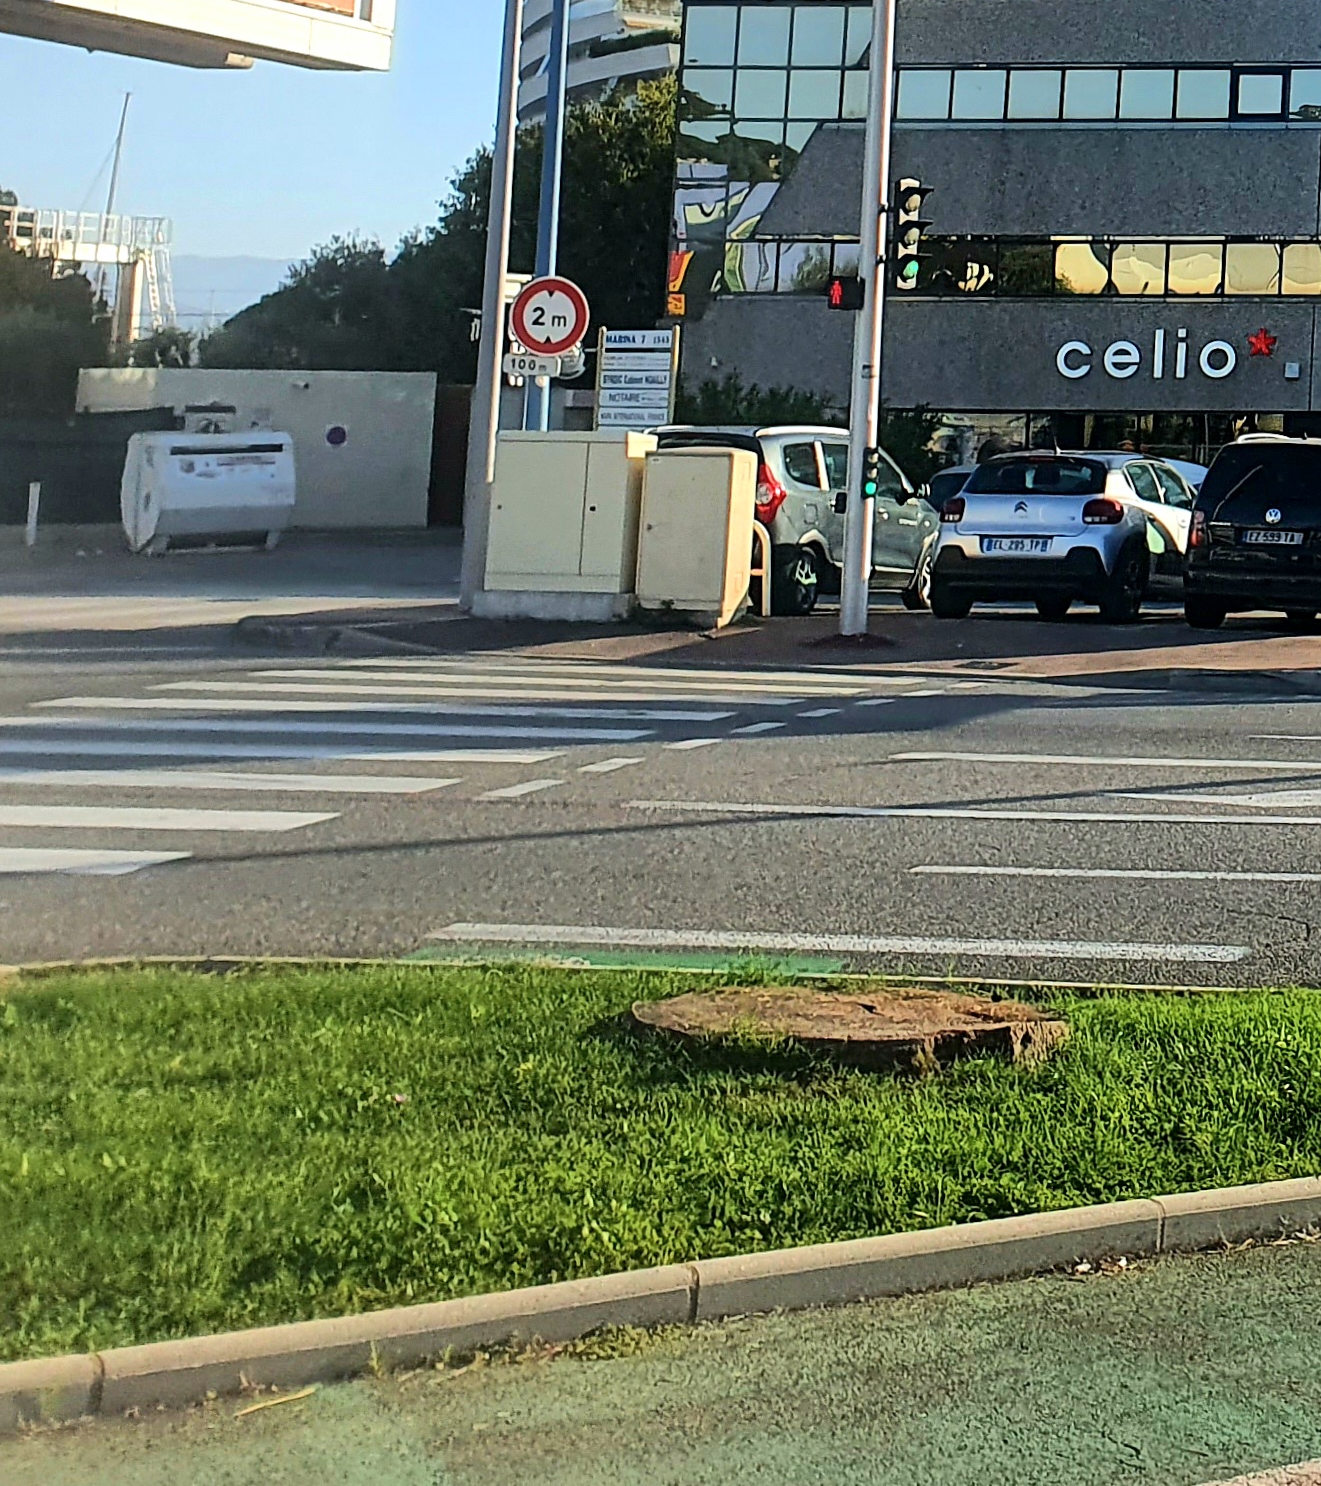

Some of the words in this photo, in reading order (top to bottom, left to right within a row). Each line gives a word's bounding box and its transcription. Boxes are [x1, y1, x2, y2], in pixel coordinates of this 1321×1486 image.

[531, 306, 546, 327] 2
[551, 314, 568, 327] m
[1056, 328, 1237, 379] celio
[510, 359, 536, 370] 100
